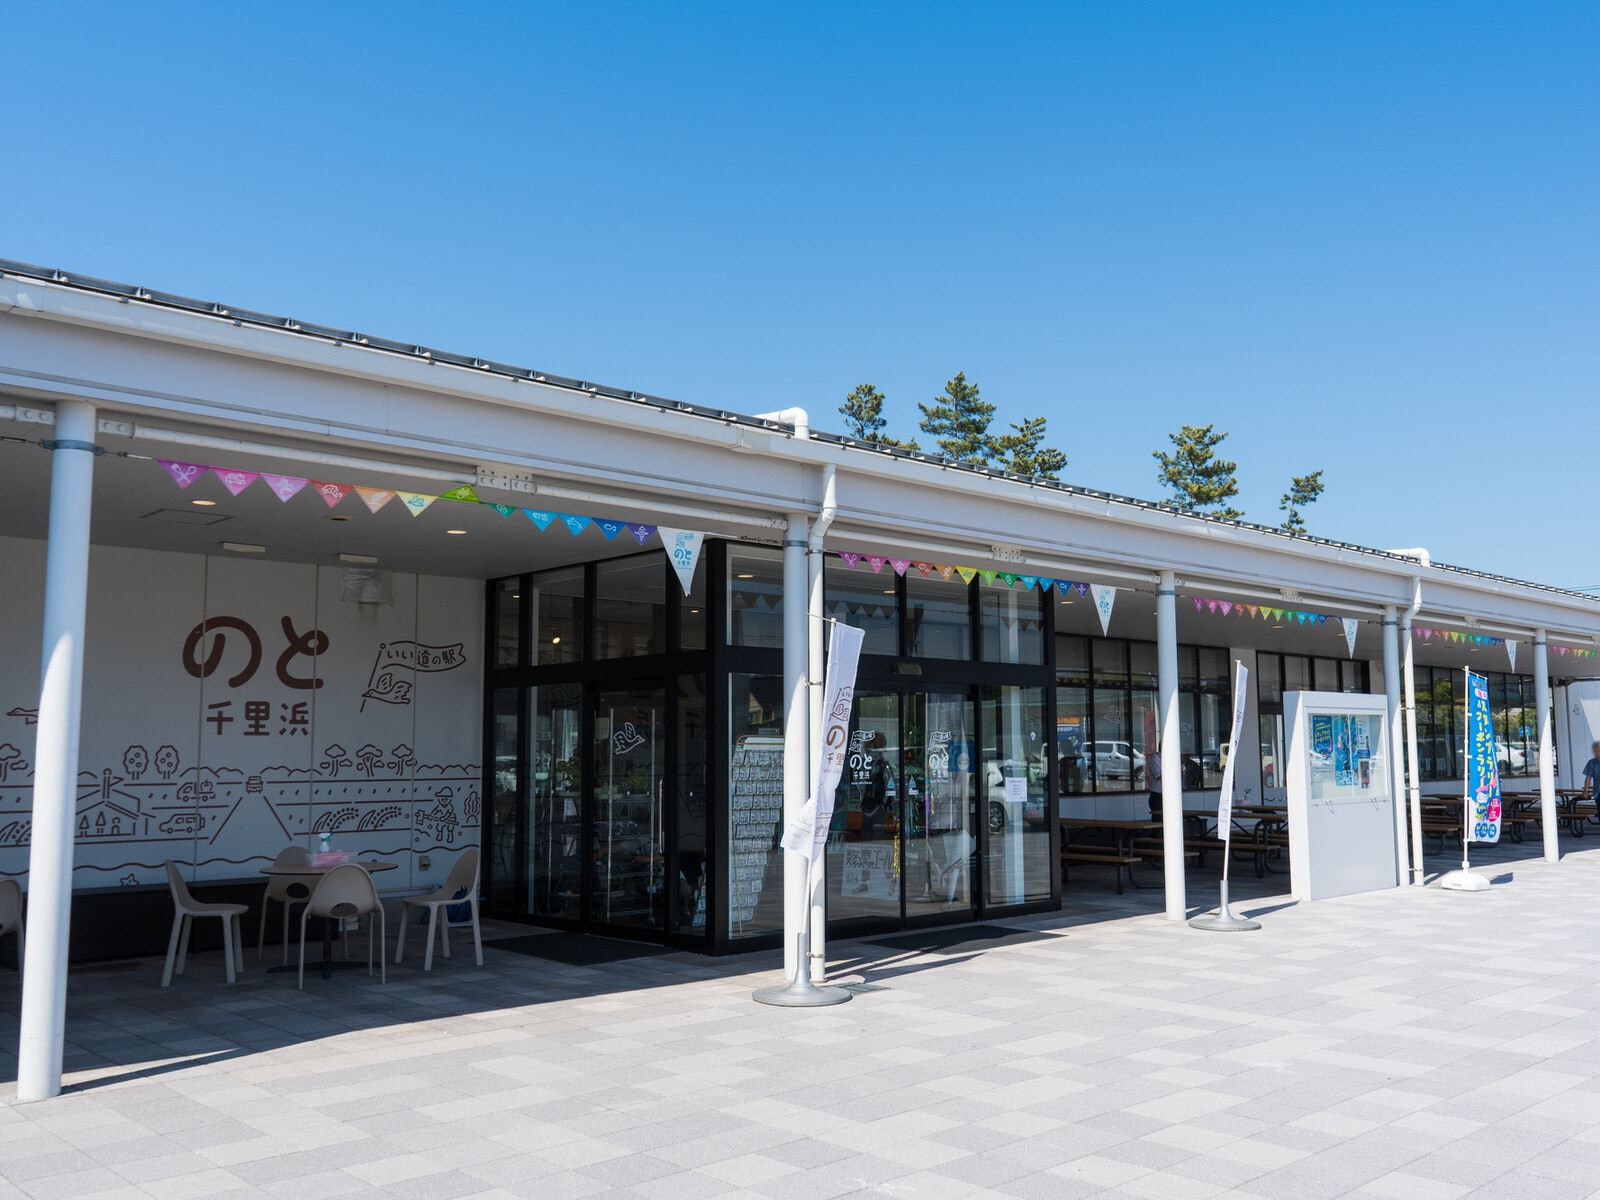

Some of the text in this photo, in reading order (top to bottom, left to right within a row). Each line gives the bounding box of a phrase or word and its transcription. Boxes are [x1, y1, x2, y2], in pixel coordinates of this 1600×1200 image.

[674, 548, 692, 560] のと
[182, 615, 330, 690] のと
[387, 649, 457, 668] いい道の駅
[206, 700, 309, 736] 千里浜
[826, 724, 846, 750] の
[827, 752, 845, 766] 千里
[849, 753, 873, 770] のと
